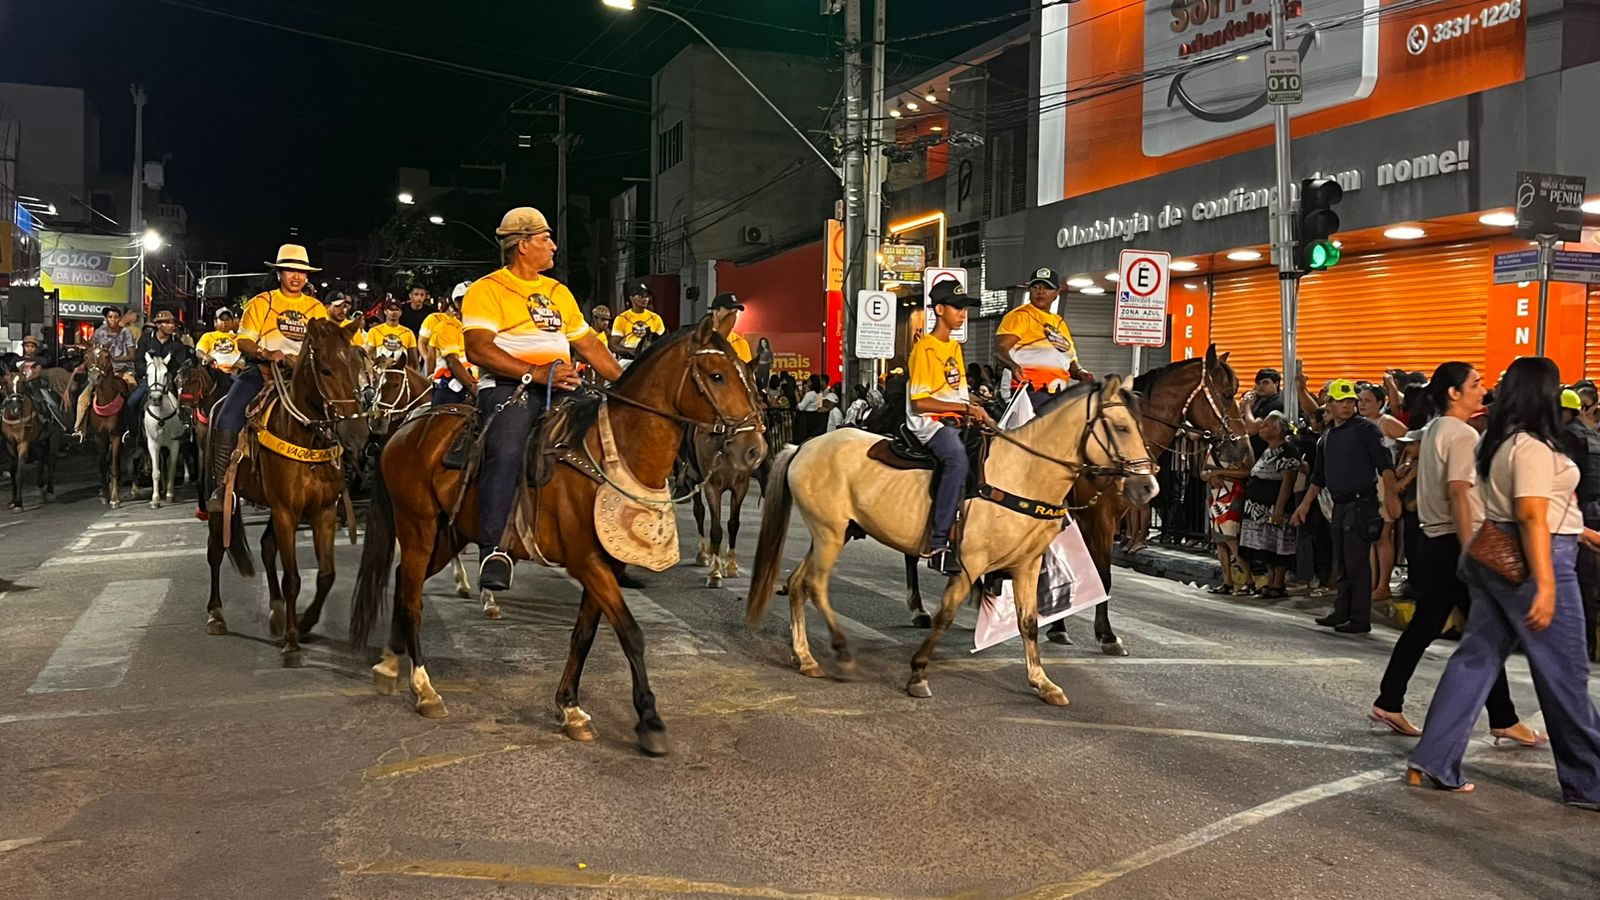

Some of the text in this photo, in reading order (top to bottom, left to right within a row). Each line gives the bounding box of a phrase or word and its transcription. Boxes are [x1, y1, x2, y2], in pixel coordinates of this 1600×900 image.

[1432, 0, 1521, 43] 3831-1228
[1268, 76, 1300, 90] 010
[1549, 190, 1583, 204] PENHA
[1056, 212, 1150, 249] Odontologia
[1158, 205, 1183, 229] de
[56, 272, 109, 284] DA MODA
[1137, 267, 1150, 288] E
[872, 301, 881, 315] E
[1121, 308, 1139, 316] ZONA
[1143, 309, 1161, 317] AZUL
[773, 354, 811, 369] mais
